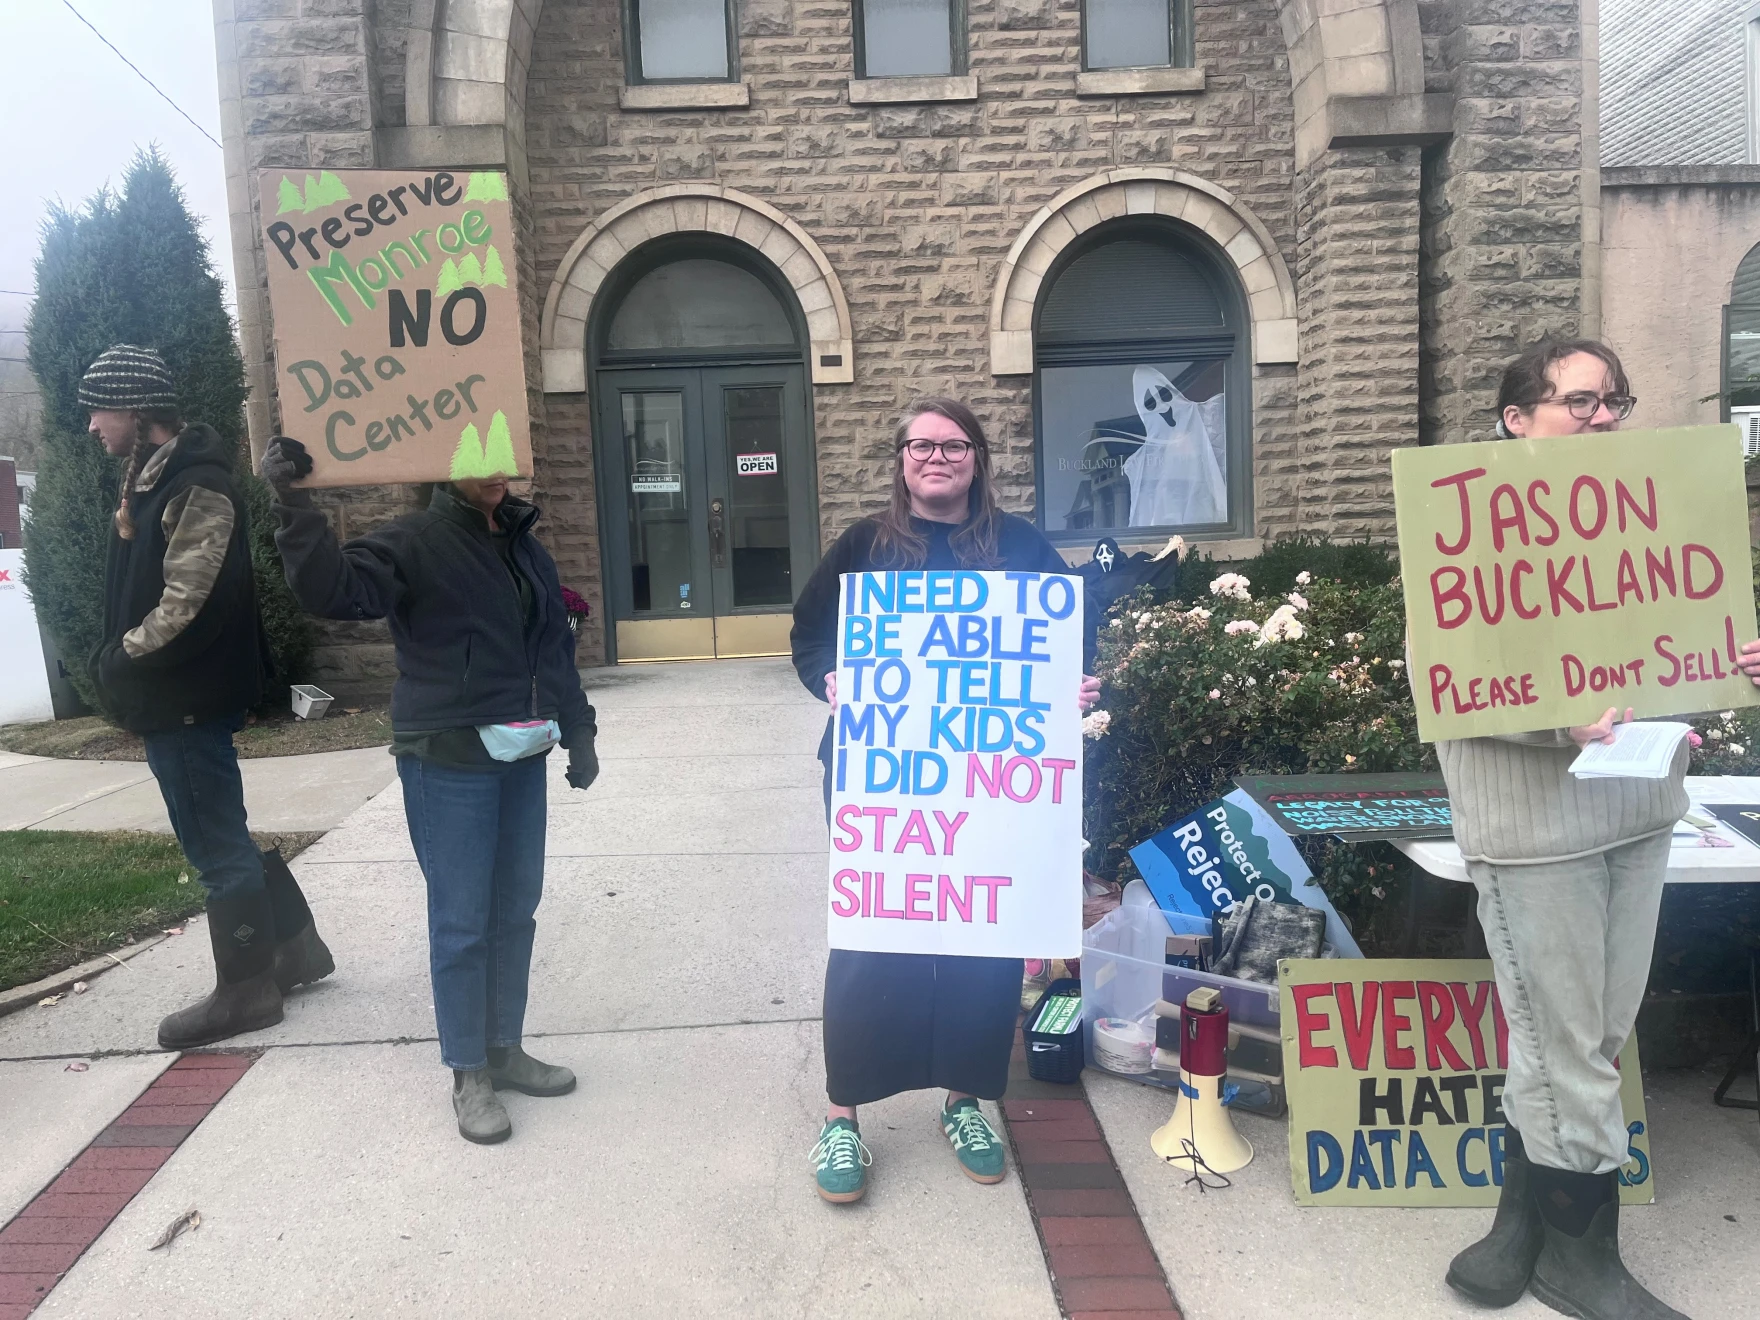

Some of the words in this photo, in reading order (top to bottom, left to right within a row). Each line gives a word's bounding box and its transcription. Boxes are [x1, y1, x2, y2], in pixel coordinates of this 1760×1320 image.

[267, 172, 462, 270] Preserve
[307, 210, 492, 327] Monroe
[388, 286, 487, 347] NO
[287, 349, 406, 413] Data
[325, 374, 486, 461] Center
[741, 462, 774, 471] OPEN
[1058, 457, 1117, 471] BUCKLAND
[1430, 467, 1658, 555] JASON
[846, 574, 856, 615] I
[861, 571, 989, 613] NEED
[1005, 572, 1075, 620] TO
[1430, 543, 1724, 629] BUCKLAND
[844, 614, 903, 658] BE
[918, 614, 1051, 662] ABLE
[1429, 663, 1539, 715] PLEASE
[1561, 654, 1644, 697] DONT
[1654, 615, 1740, 687] SELL!
[843, 657, 911, 703] TO
[926, 659, 1051, 711] TELL
[838, 703, 909, 747] MY
[929, 705, 1046, 757] KIDS
[836, 748, 847, 792] I
[865, 748, 948, 795] DID
[966, 753, 1076, 804] NOT
[833, 804, 969, 856] STAY
[1277, 800, 1363, 810] LEGACY
[1371, 799, 1430, 807] FOR
[1283, 809, 1357, 819] NOISE
[1297, 820, 1400, 830] WASTED
[1374, 813, 1452, 821] SHORT
[1173, 820, 1244, 914] Reject
[1207, 806, 1261, 884] Protect
[831, 868, 1012, 924] SILENT
[1291, 980, 1509, 1071] EVERY
[1306, 1129, 1448, 1194] DATA
